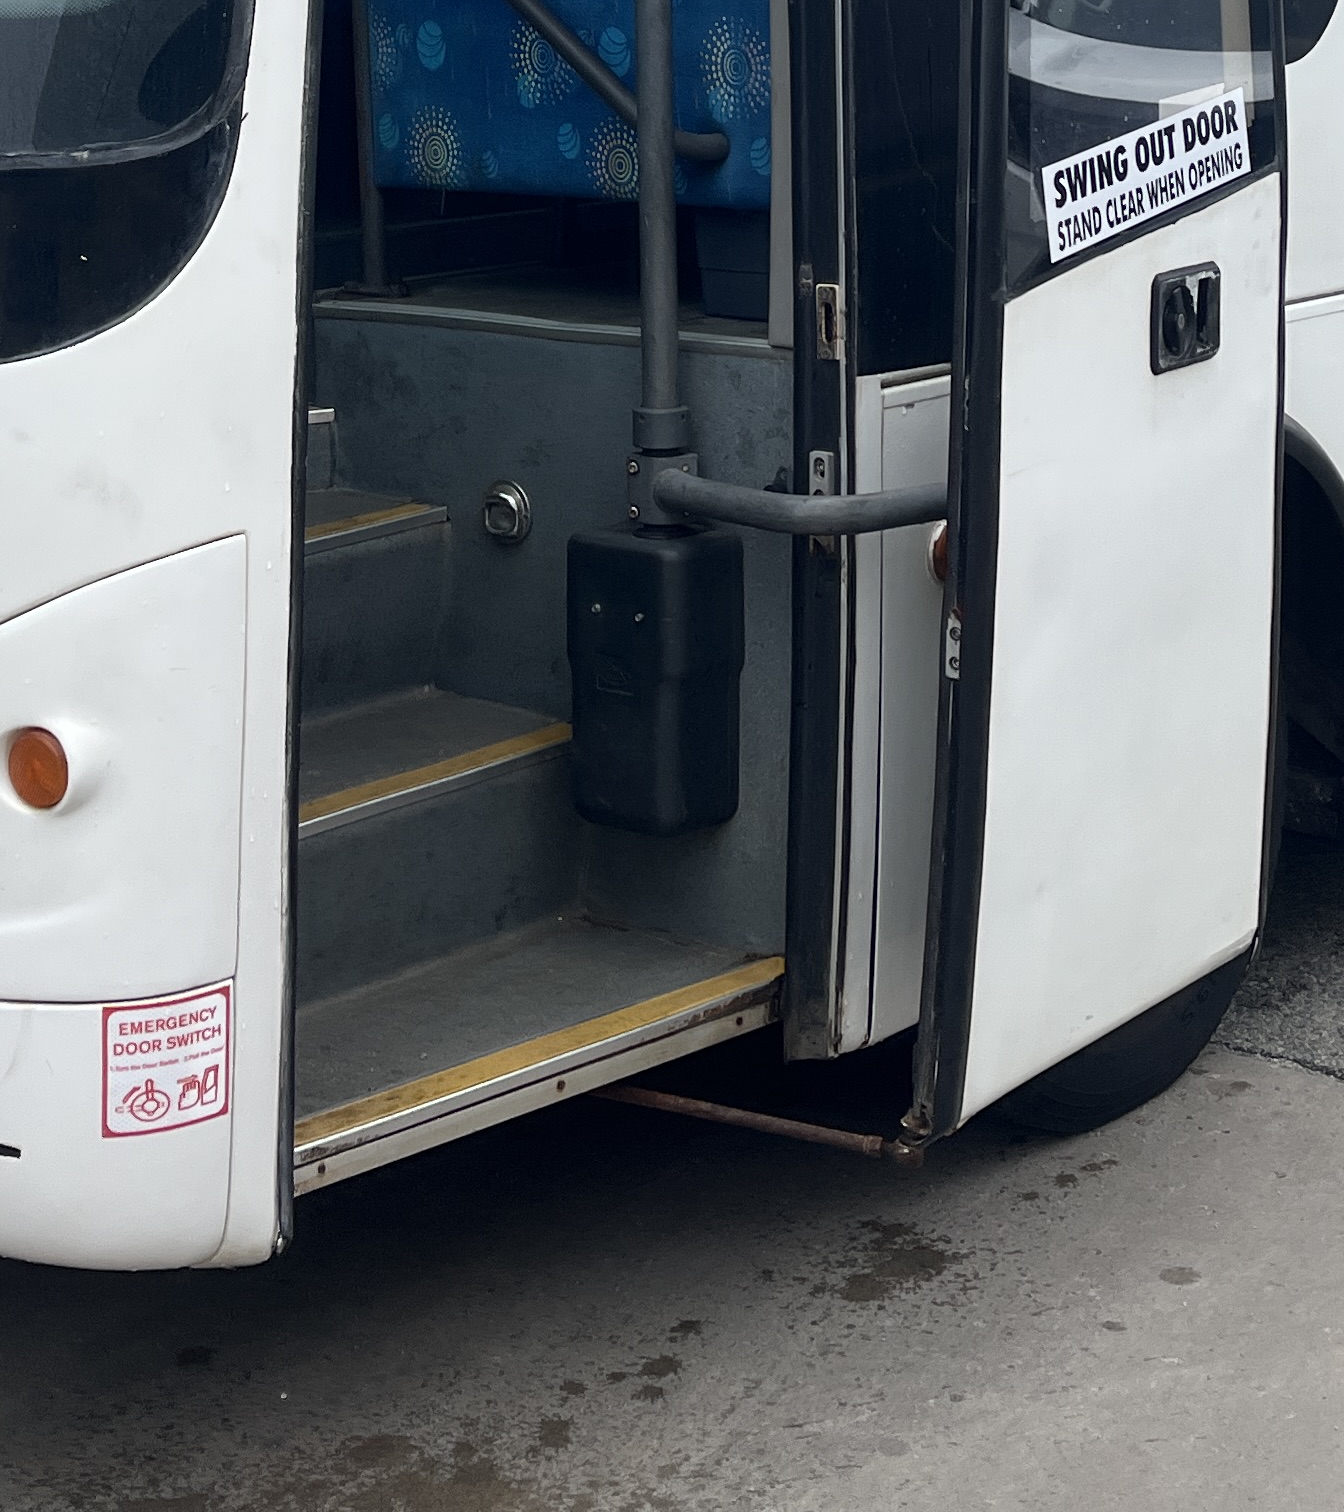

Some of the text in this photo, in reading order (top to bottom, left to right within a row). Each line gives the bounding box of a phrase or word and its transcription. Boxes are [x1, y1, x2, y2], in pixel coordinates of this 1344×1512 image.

[1053, 100, 1239, 208] SWING OUT DOOR
[1057, 142, 1243, 251] STAND CLEAR WHEN OPENING
[113, 1024, 222, 1056] DOOR SWITCH
[119, 1005, 217, 1036] EMERGENCY
